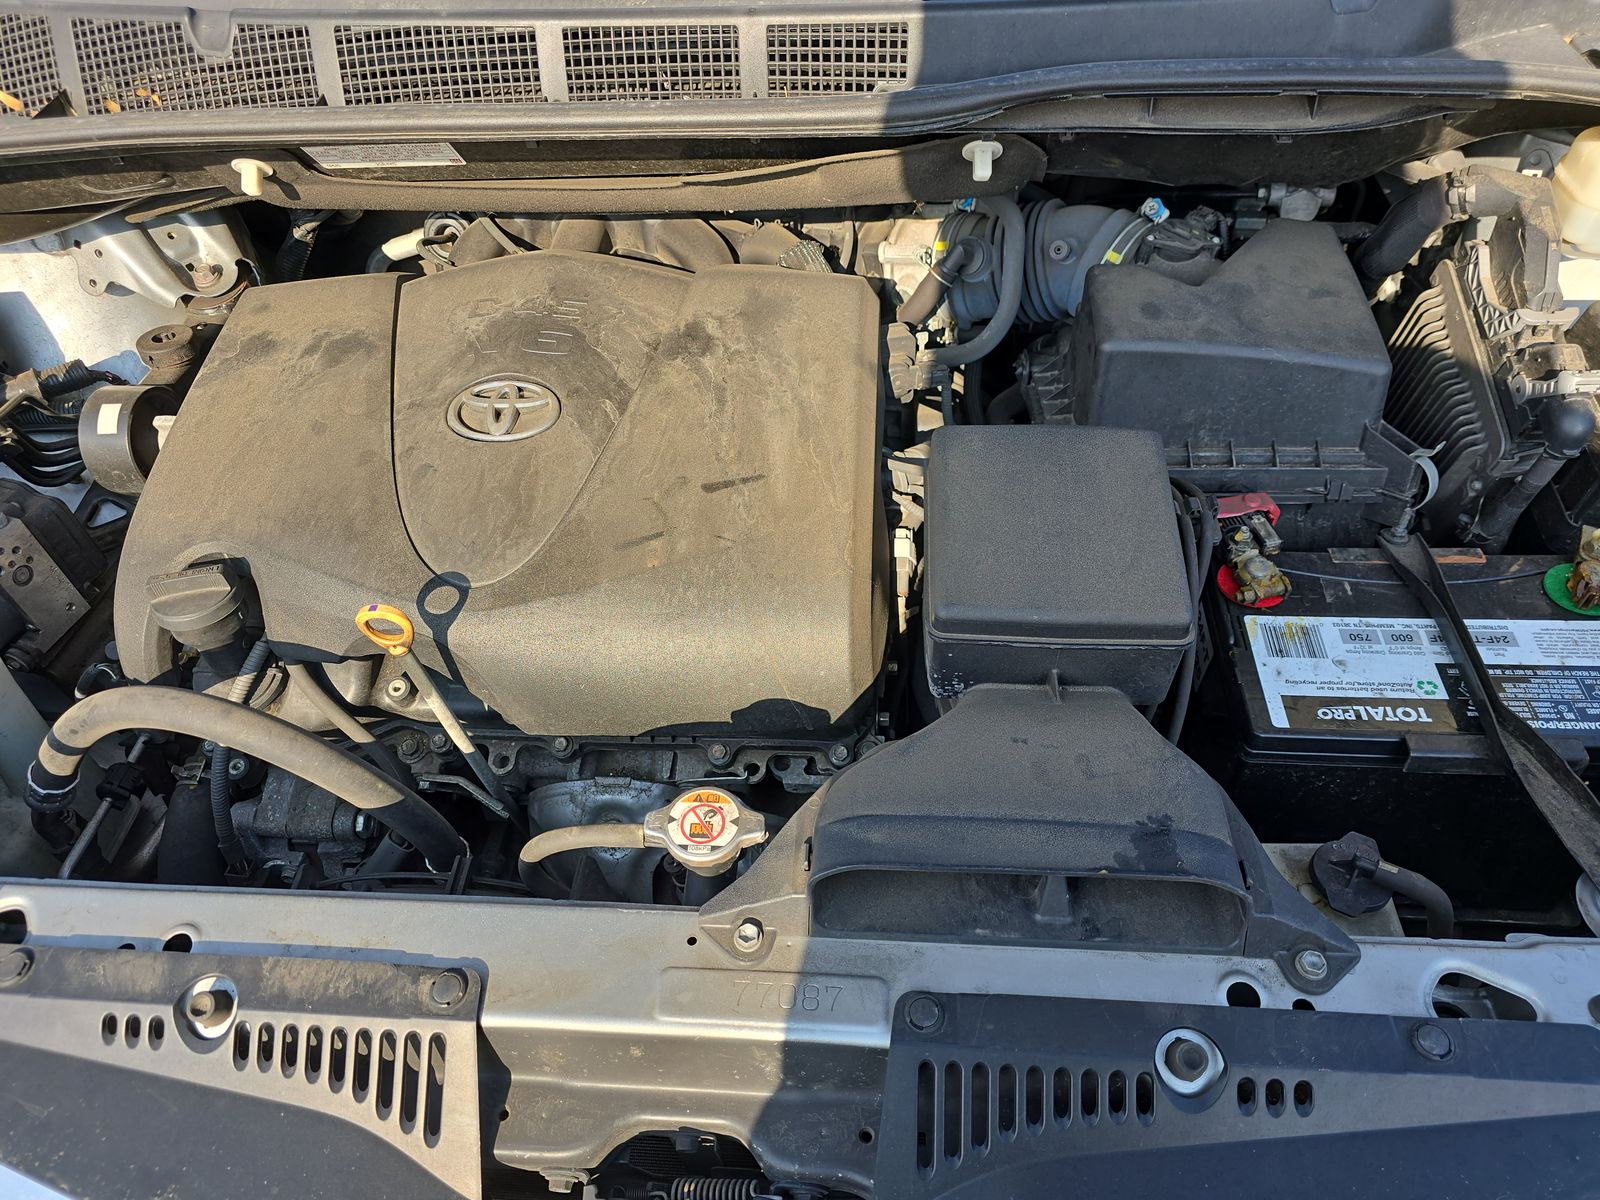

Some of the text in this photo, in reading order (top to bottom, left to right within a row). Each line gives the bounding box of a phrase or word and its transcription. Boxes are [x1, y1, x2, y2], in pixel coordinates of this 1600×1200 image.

[1349, 633, 1372, 642] 750
[1390, 634, 1413, 642] 600
[1317, 706, 1432, 722] TOTALPRO
[1527, 720, 1600, 729] DANGER/POIS
[732, 980, 844, 1012] 77087
